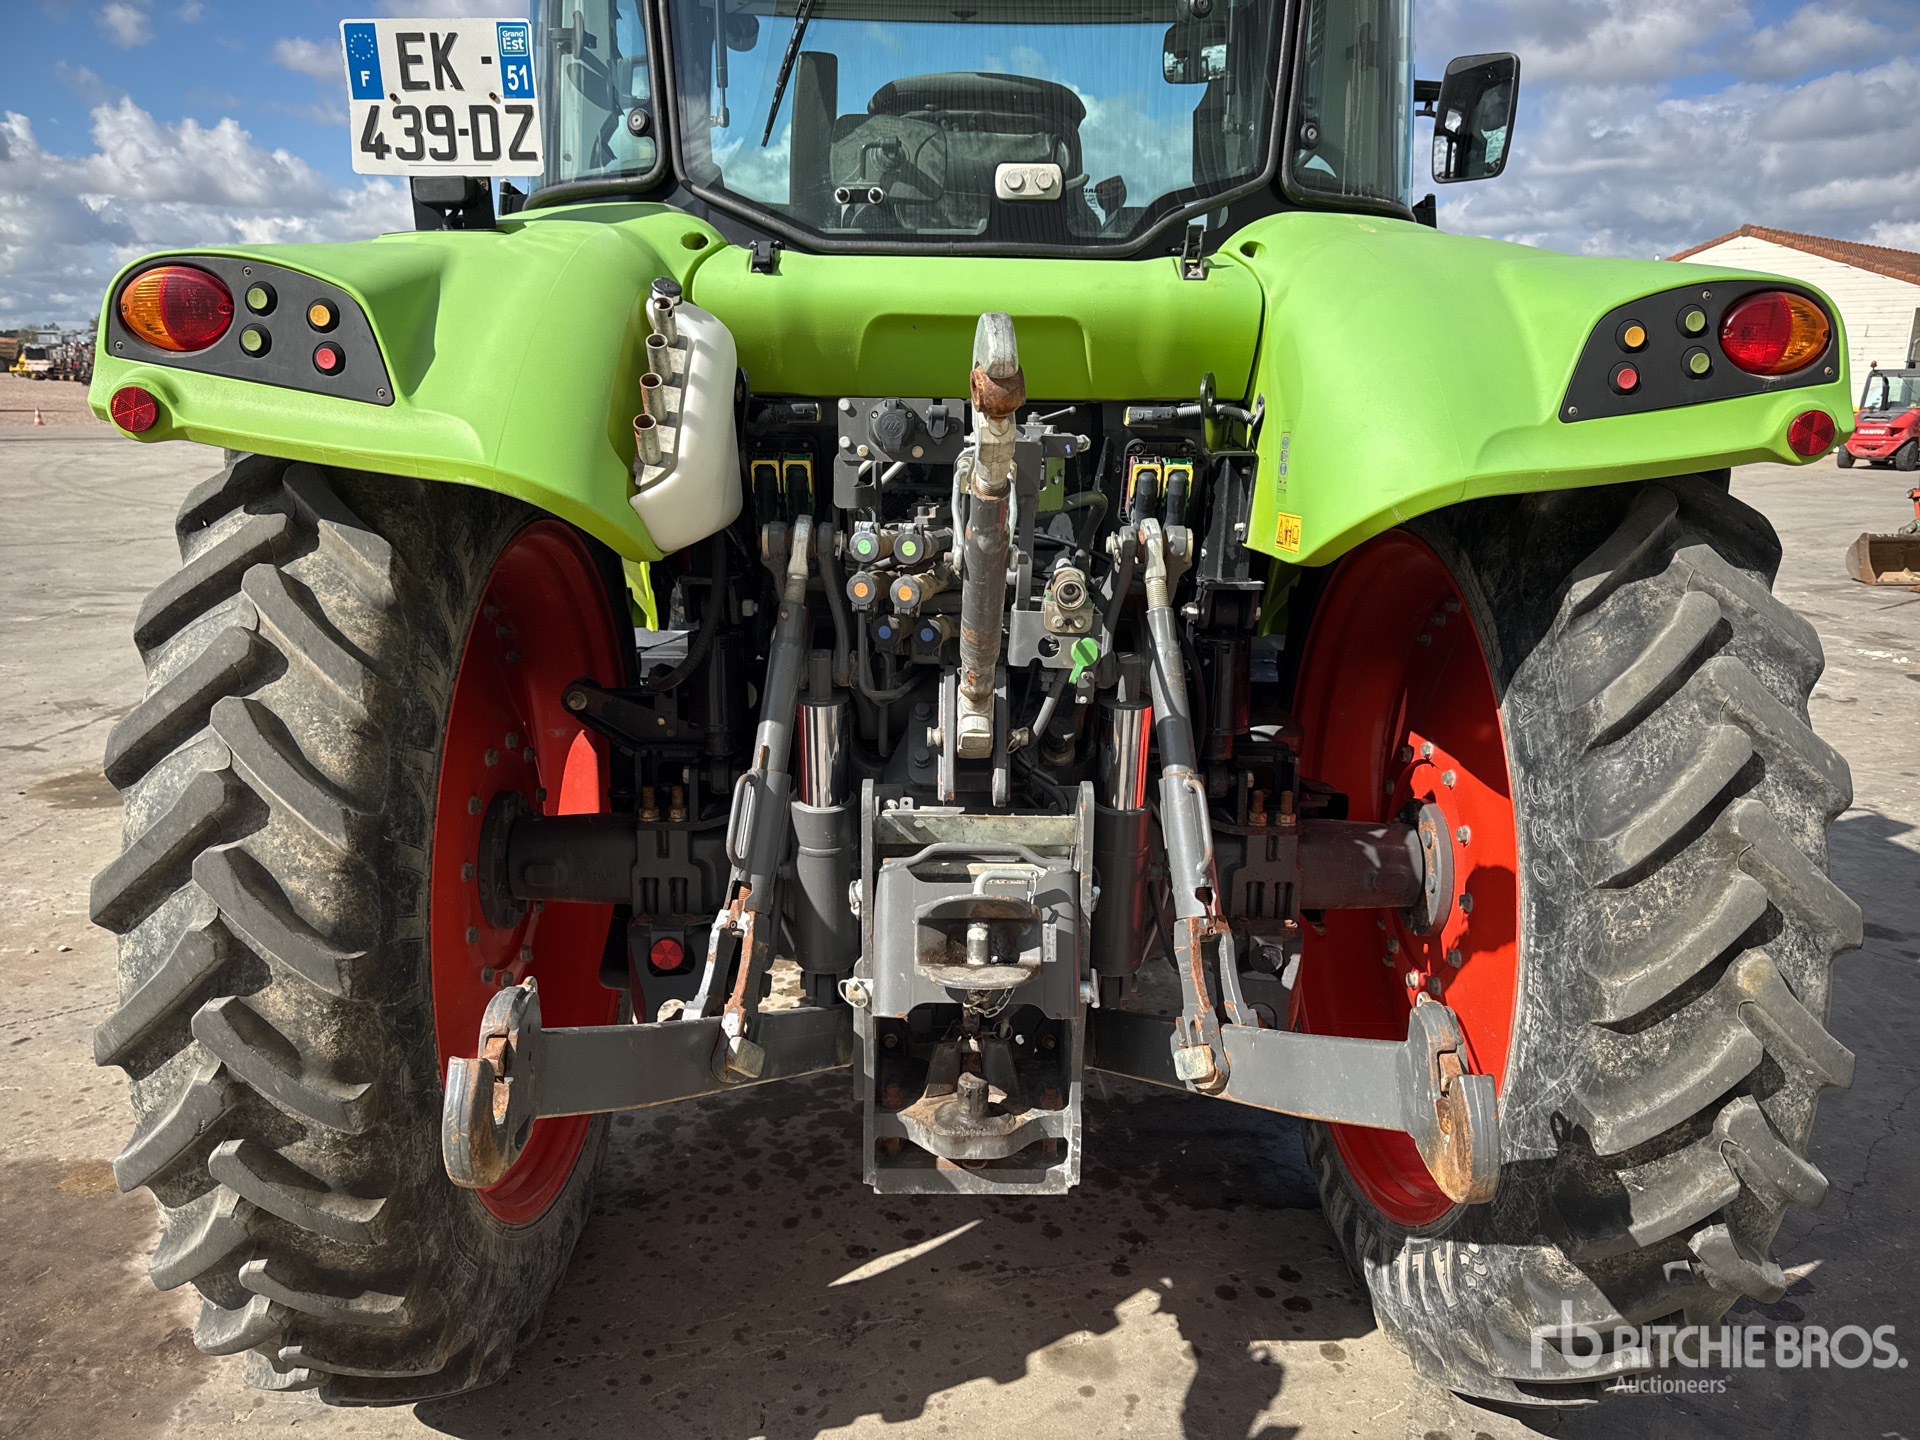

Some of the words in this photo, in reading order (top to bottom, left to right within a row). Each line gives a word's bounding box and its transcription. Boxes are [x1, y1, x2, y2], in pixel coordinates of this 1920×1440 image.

[503, 37, 524, 50] Est
[396, 33, 464, 90] EK
[361, 71, 370, 87] F
[507, 64, 529, 91] 51
[361, 105, 538, 161] 439-DZ
